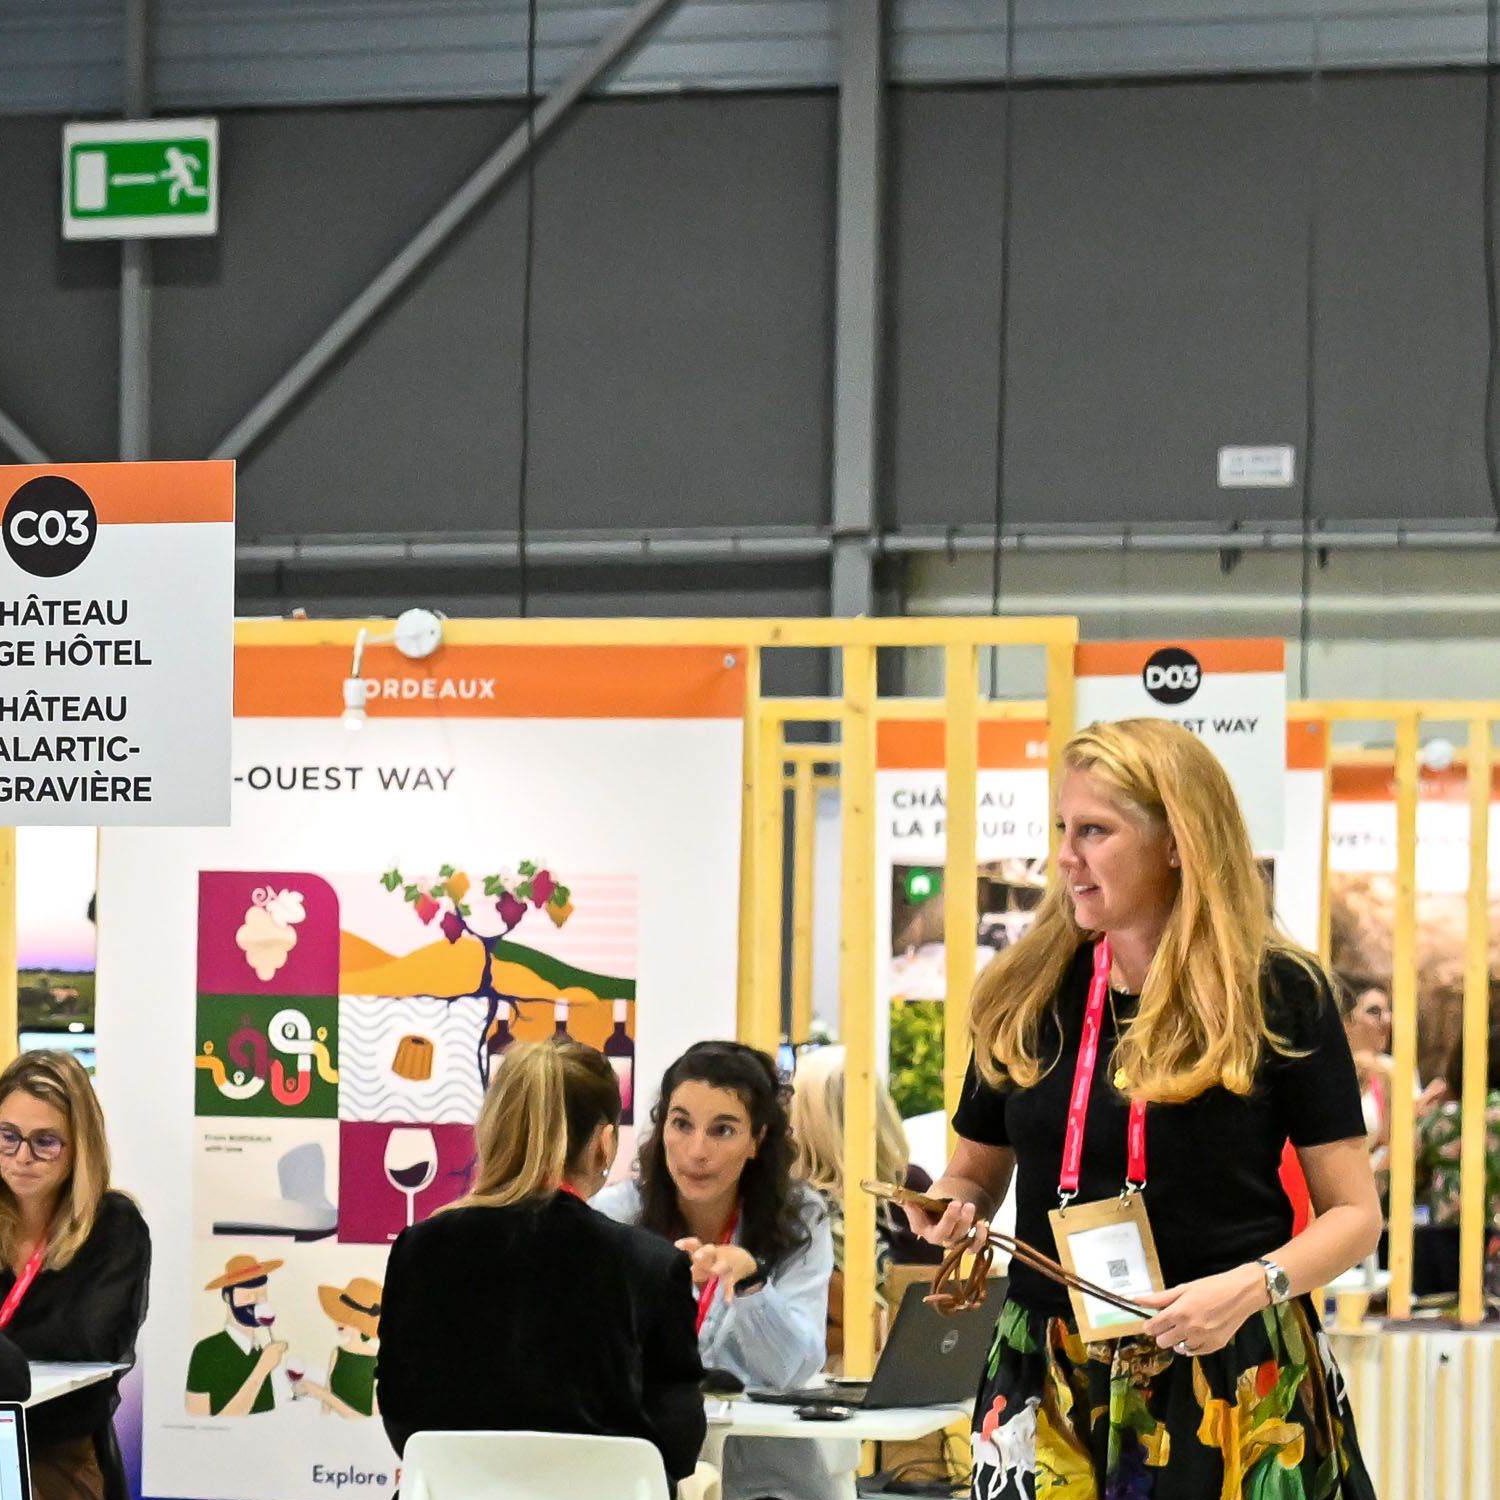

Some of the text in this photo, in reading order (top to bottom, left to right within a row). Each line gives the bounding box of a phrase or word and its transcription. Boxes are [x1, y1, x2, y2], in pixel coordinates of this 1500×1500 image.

[9, 509, 88, 548] C03
[44, 632, 152, 667] HÔTEL
[345, 678, 496, 699] ORDEAUX
[1146, 665, 1198, 689] D03
[1213, 718, 1259, 734] WAY
[234, 767, 455, 792] -OUEST WAY
[892, 786, 1014, 808] CHÂAU
[892, 821, 922, 837] LA
[312, 1465, 388, 1489] Explore
